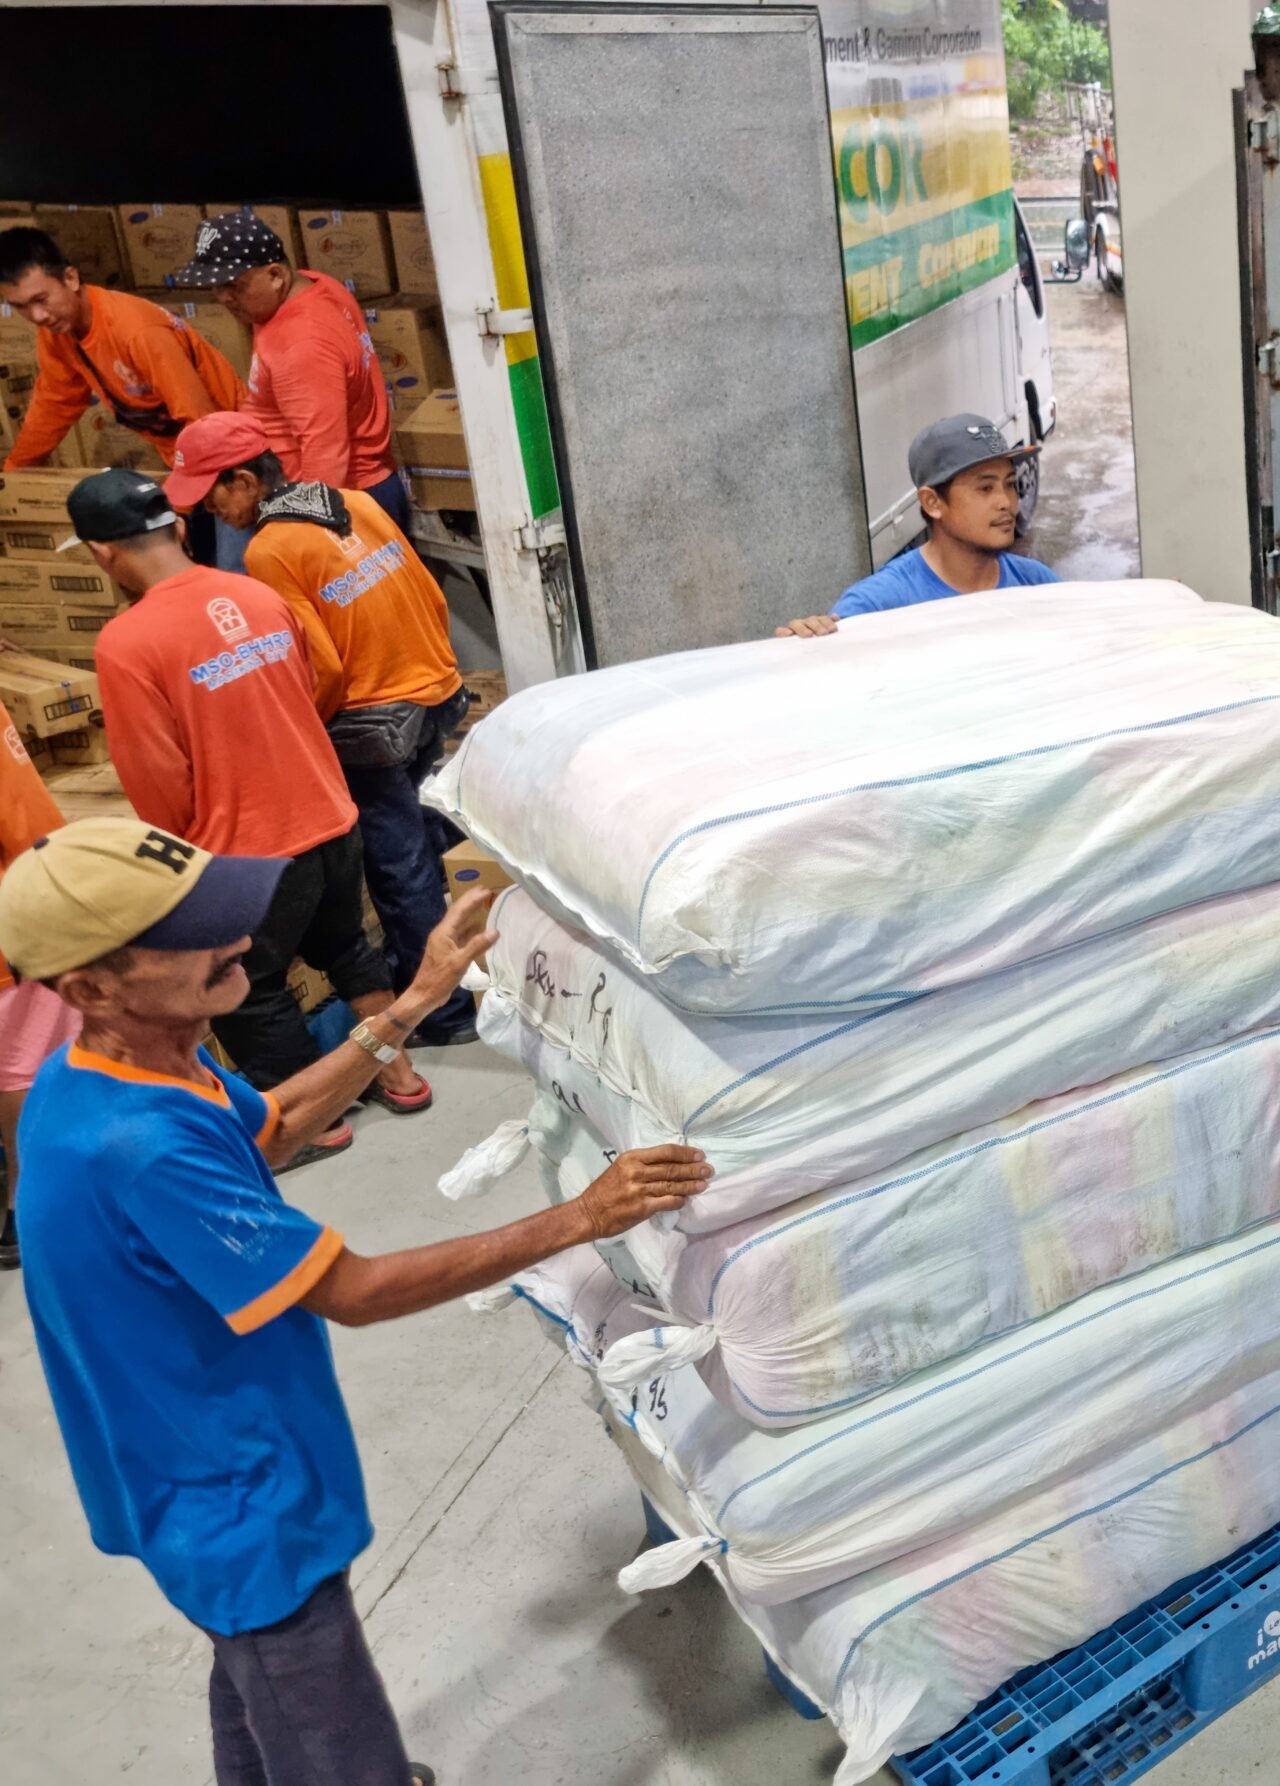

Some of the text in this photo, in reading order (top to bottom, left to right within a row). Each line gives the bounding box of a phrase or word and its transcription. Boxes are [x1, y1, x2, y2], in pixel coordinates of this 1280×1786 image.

[876, 27, 922, 64] Gaming
[923, 24, 982, 60] Corporation
[135, 830, 196, 875] H
